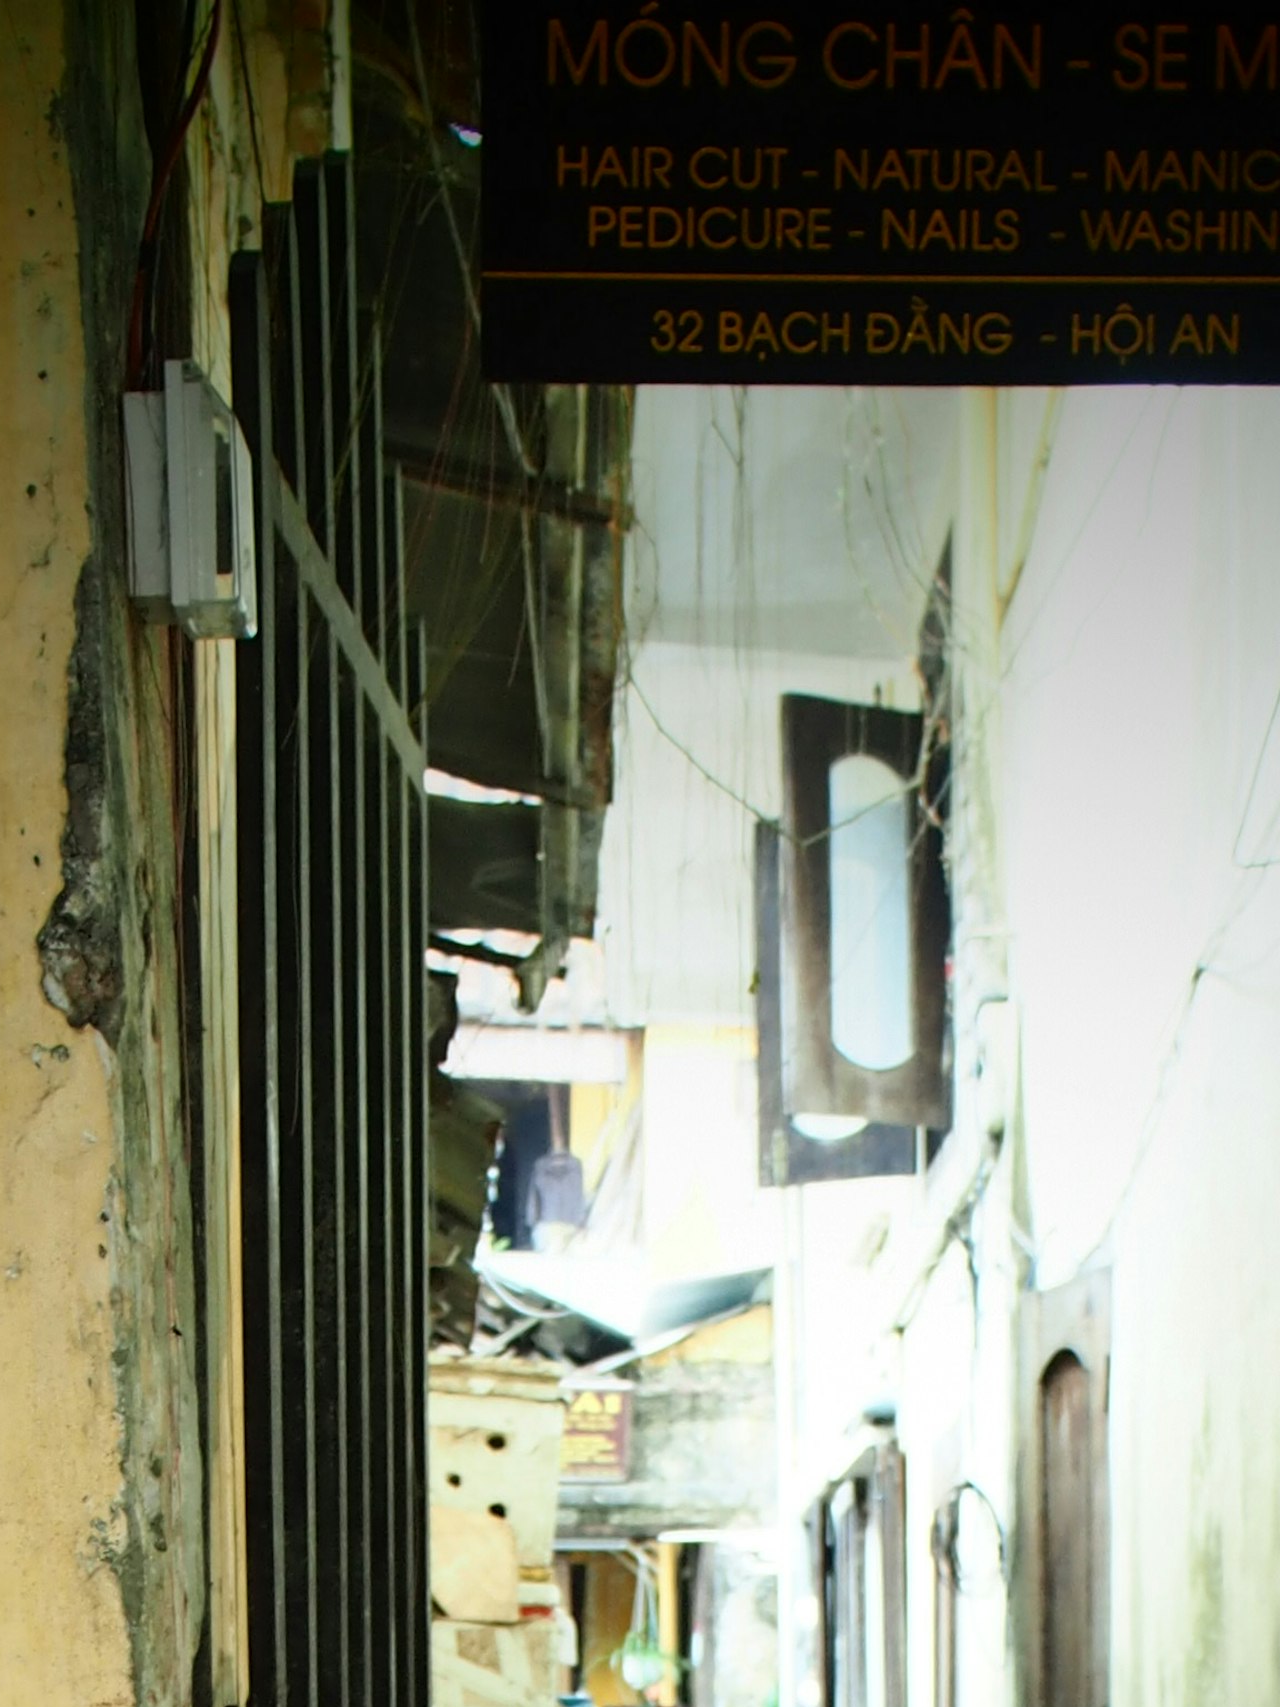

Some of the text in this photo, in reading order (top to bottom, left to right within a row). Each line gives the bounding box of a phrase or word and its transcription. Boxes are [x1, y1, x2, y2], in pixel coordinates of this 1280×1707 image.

[546, 2, 800, 91] MÓNG
[821, 9, 1044, 92] CHÂN
[1111, 21, 1191, 93] SE
[555, 145, 676, 191] HAIR
[688, 147, 792, 192] CUT
[833, 149, 1059, 194] NATURAL
[587, 205, 834, 252] PEDICURE
[880, 208, 1023, 254] NAILS
[650, 309, 707, 354] 32
[717, 310, 855, 364] BẠCH
[864, 296, 1016, 357] ĐẰNG
[1071, 302, 1159, 365] HỘI
[1169, 313, 1243, 356] AN
